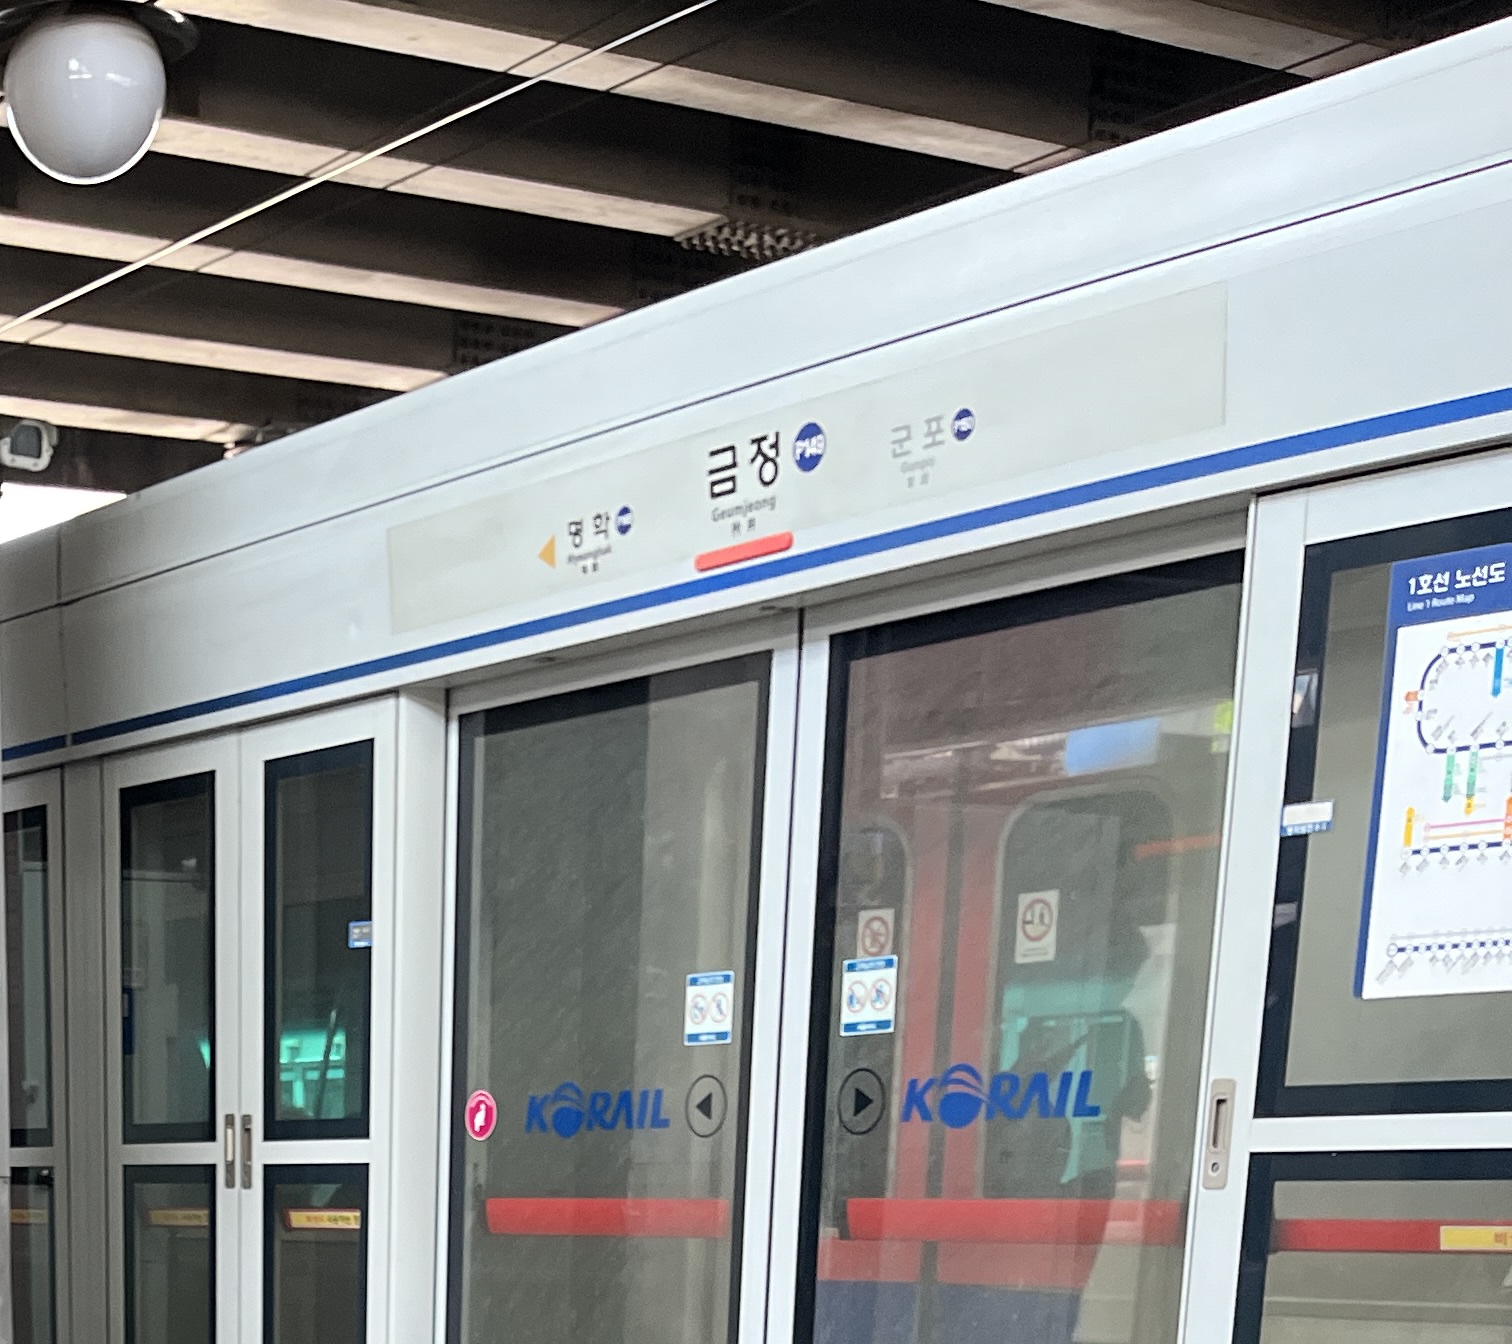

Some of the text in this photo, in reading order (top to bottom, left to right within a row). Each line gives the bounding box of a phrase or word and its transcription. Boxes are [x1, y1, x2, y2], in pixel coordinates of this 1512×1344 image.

[890, 414, 945, 458] 군포
[707, 430, 780, 499] 금정
[711, 495, 777, 523] Geumjeong
[567, 511, 611, 549] 명학
[1408, 561, 1506, 596] 1호선 노선도
[1407, 601, 1425, 613] Line
[1431, 597, 1455, 608] Route
[1455, 593, 1476, 605] Map
[524, 1080, 671, 1140] KORAIL
[900, 1062, 1102, 1130] KORAIL
